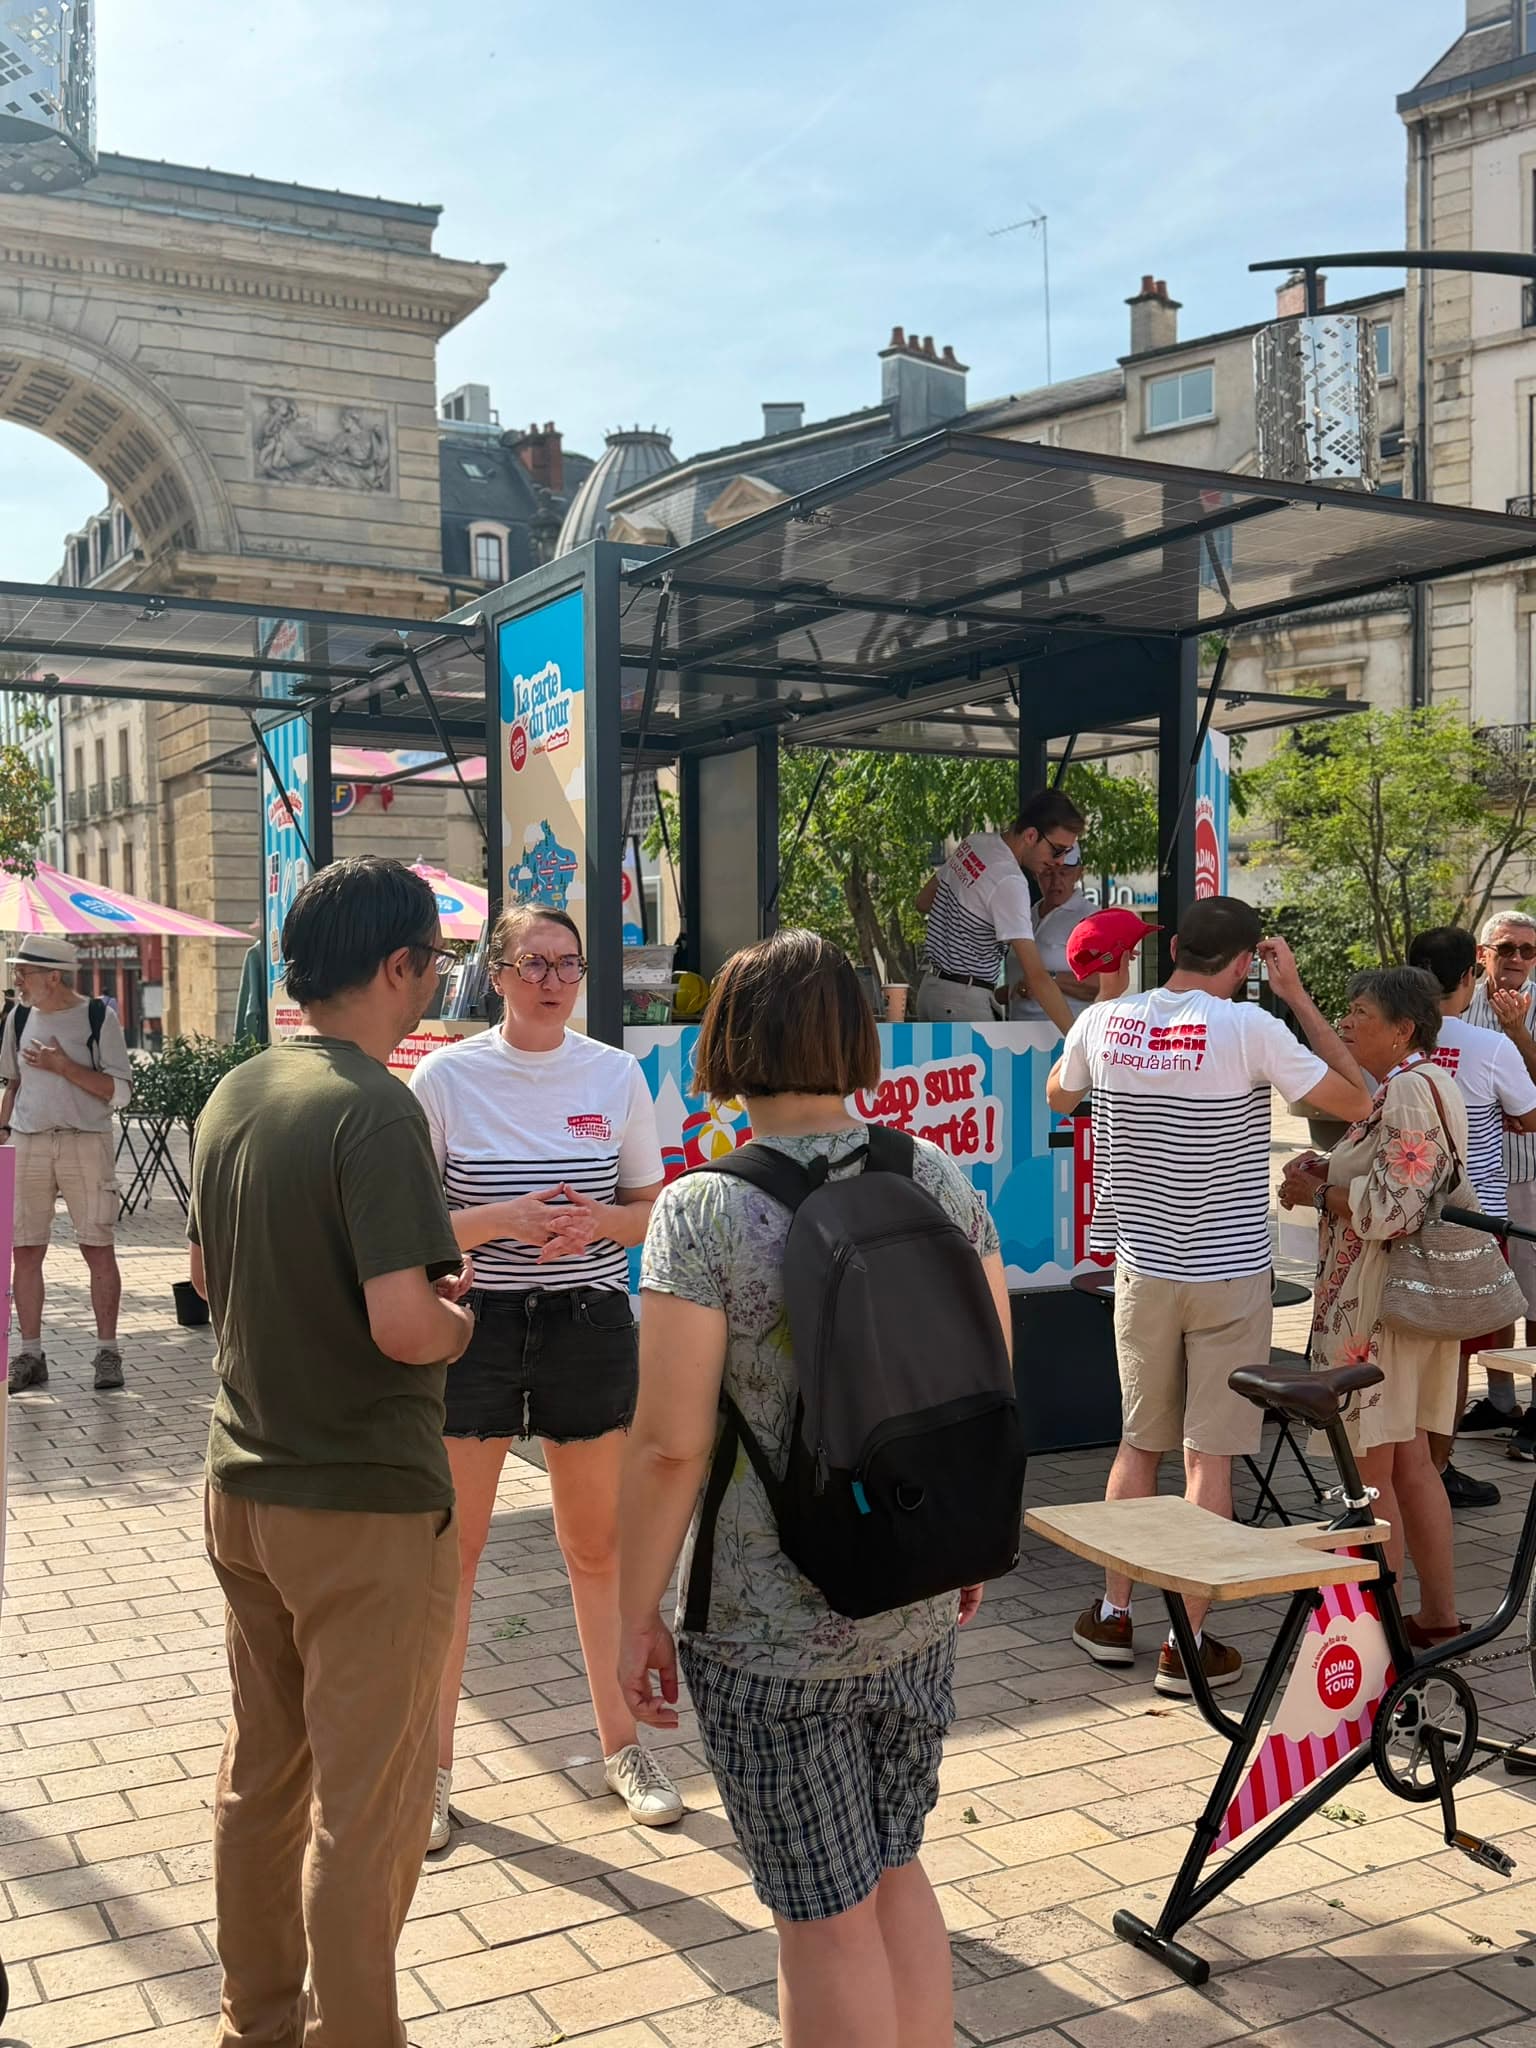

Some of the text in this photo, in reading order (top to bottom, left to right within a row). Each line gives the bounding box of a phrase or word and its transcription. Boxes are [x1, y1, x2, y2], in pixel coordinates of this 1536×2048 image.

[516, 671, 559, 716] La carte
[530, 704, 545, 741] du
[545, 697, 570, 733] tour
[1107, 1015, 1207, 1038] mon corps
[1104, 1030, 1143, 1049] mon
[1432, 1046, 1461, 1058] rps
[854, 1064, 977, 1123] Cap sur
[1324, 1659, 1355, 1680] ADMD
[1325, 1677, 1355, 1696] TOUR
